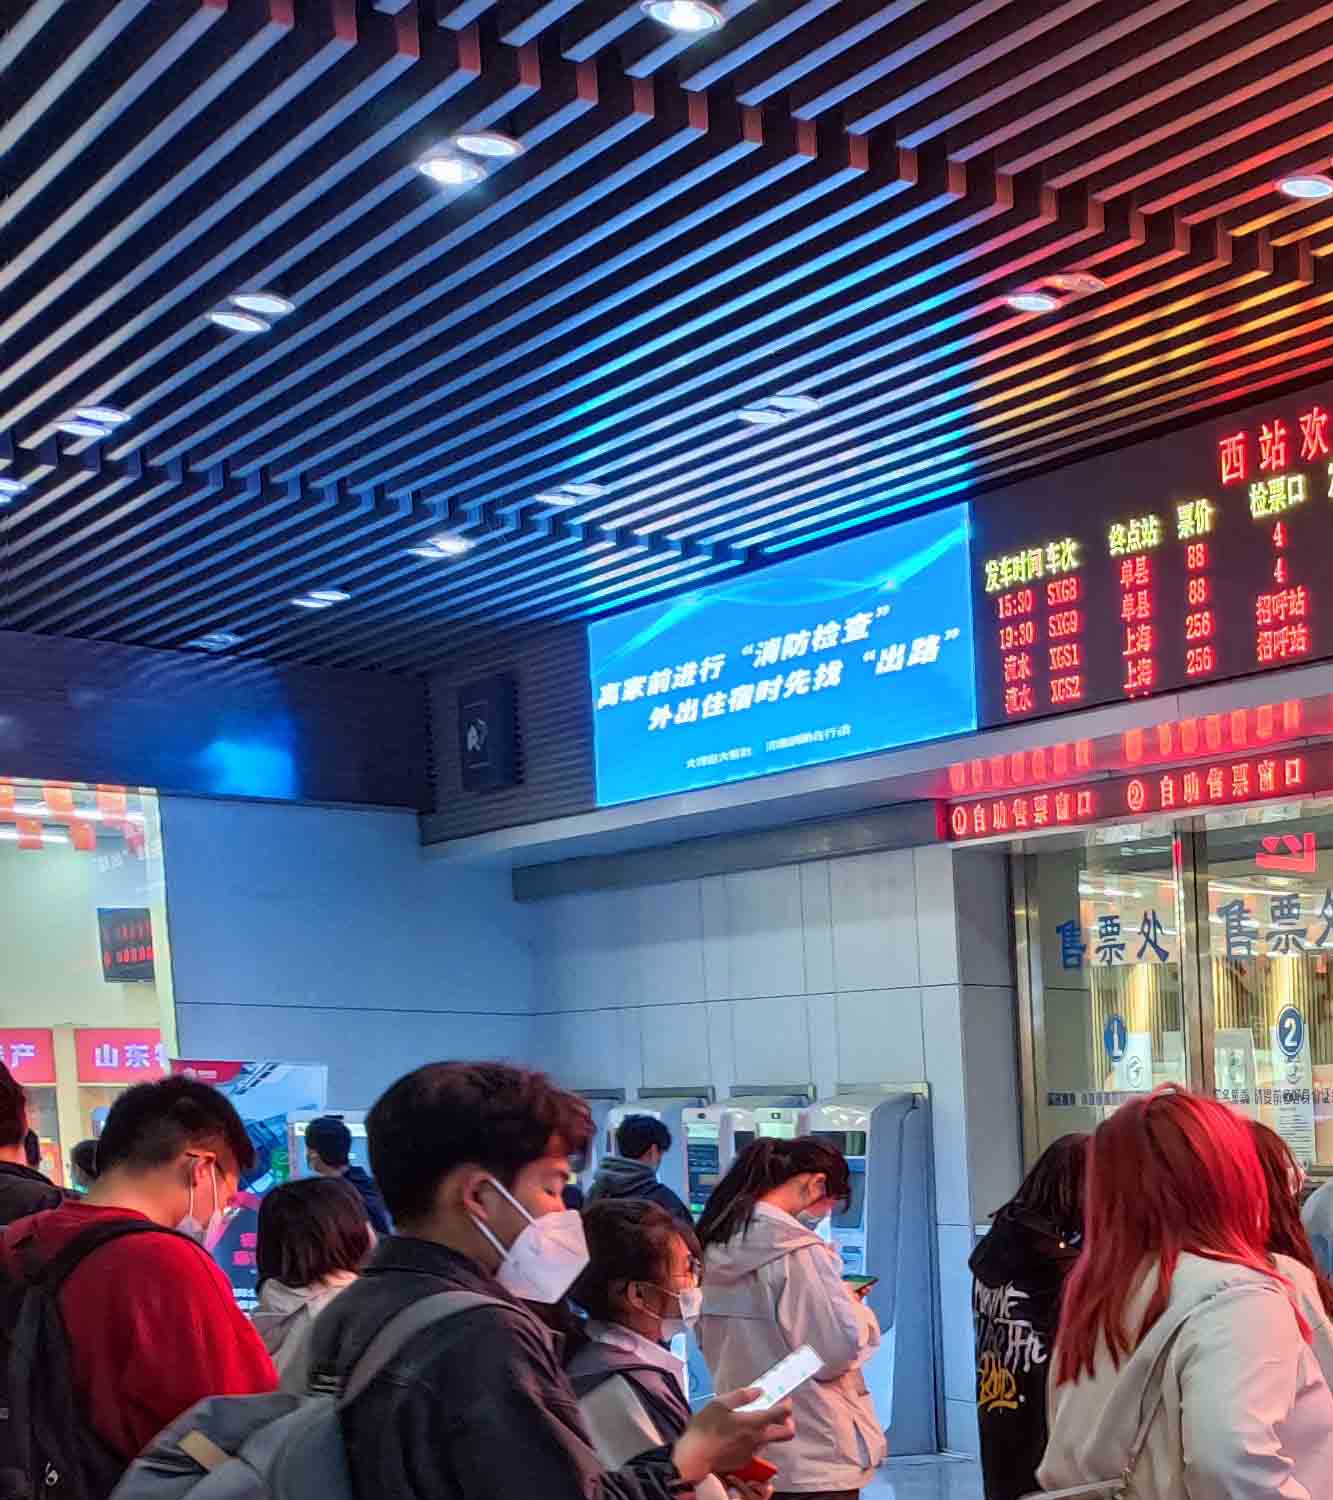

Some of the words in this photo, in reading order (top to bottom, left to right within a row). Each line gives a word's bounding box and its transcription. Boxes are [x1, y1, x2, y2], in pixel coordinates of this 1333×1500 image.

[985, 547, 1043, 592] 发车时间
[1046, 538, 1078, 573] 车次
[1109, 515, 1159, 556] 终点站
[1177, 499, 1215, 539] 票价
[1250, 473, 1306, 519] 检票口
[1272, 521, 1284, 548] 4
[1273, 557, 1285, 584] 4
[1186, 612, 1211, 641] 256
[1186, 647, 1212, 675] 256
[1159, 758, 1301, 807] 自助售票窗口
[1056, 909, 1170, 971] 售票处
